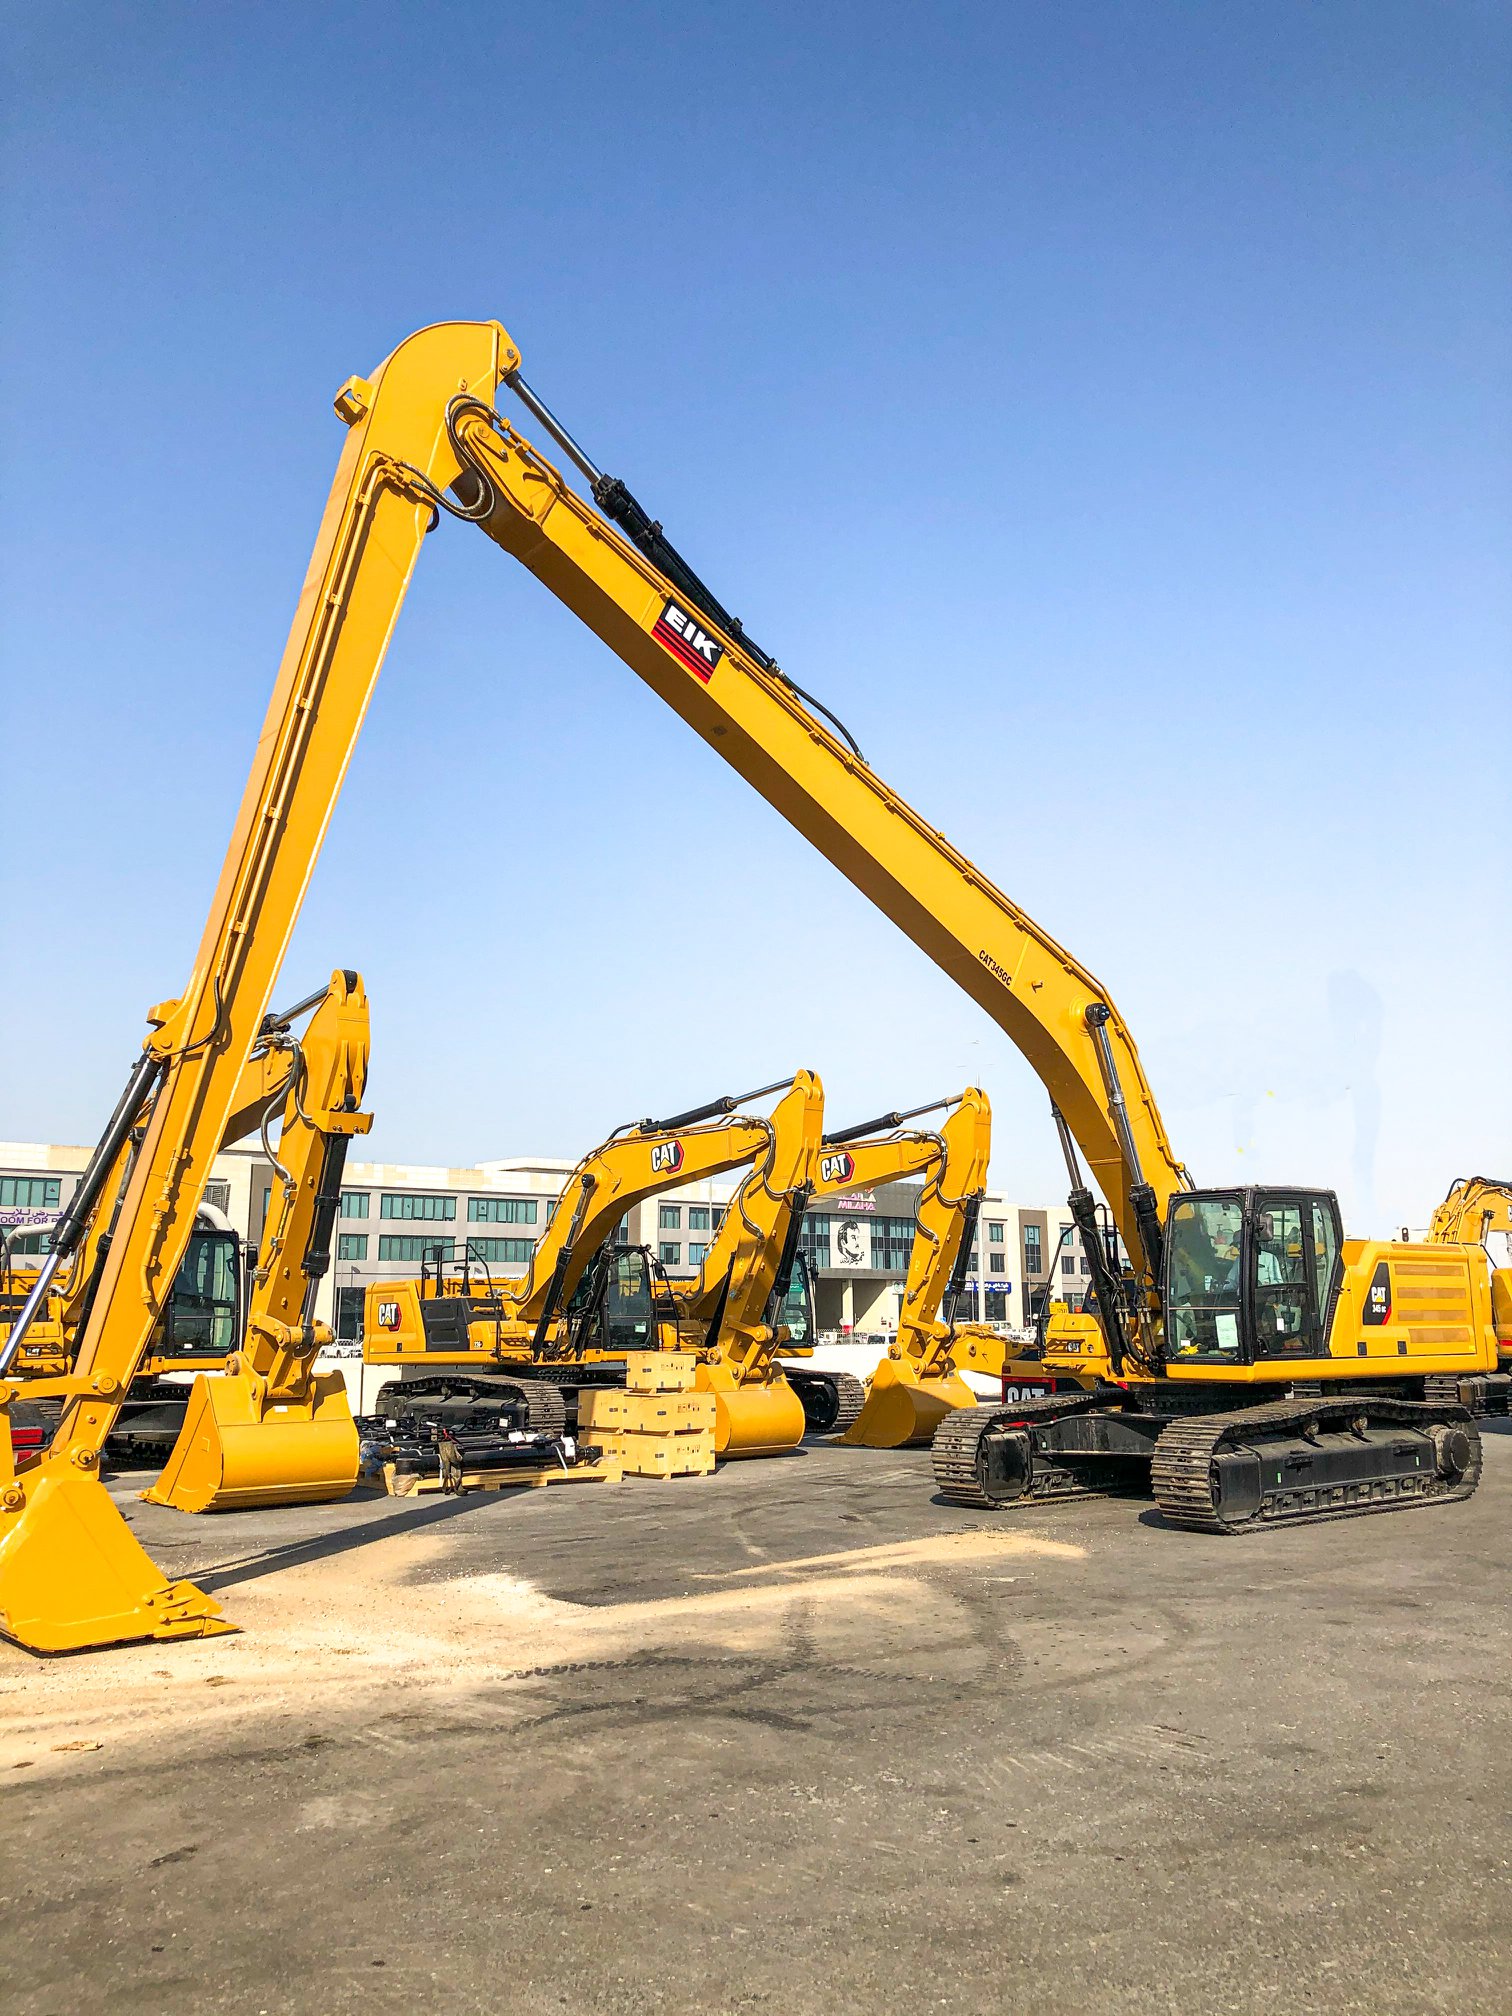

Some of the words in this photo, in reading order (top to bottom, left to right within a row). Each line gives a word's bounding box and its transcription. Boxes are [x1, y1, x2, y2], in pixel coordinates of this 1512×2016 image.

[664, 604, 719, 662] EIK
[978, 949, 1012, 986] CAT345GC
[651, 1141, 676, 1172] CAT
[821, 1153, 846, 1182] CAT
[27, 1216, 49, 1225] FOR
[1371, 1286, 1386, 1303] CAT
[378, 1303, 397, 1326] CAT
[1067, 1342, 1080, 1353] CAT
